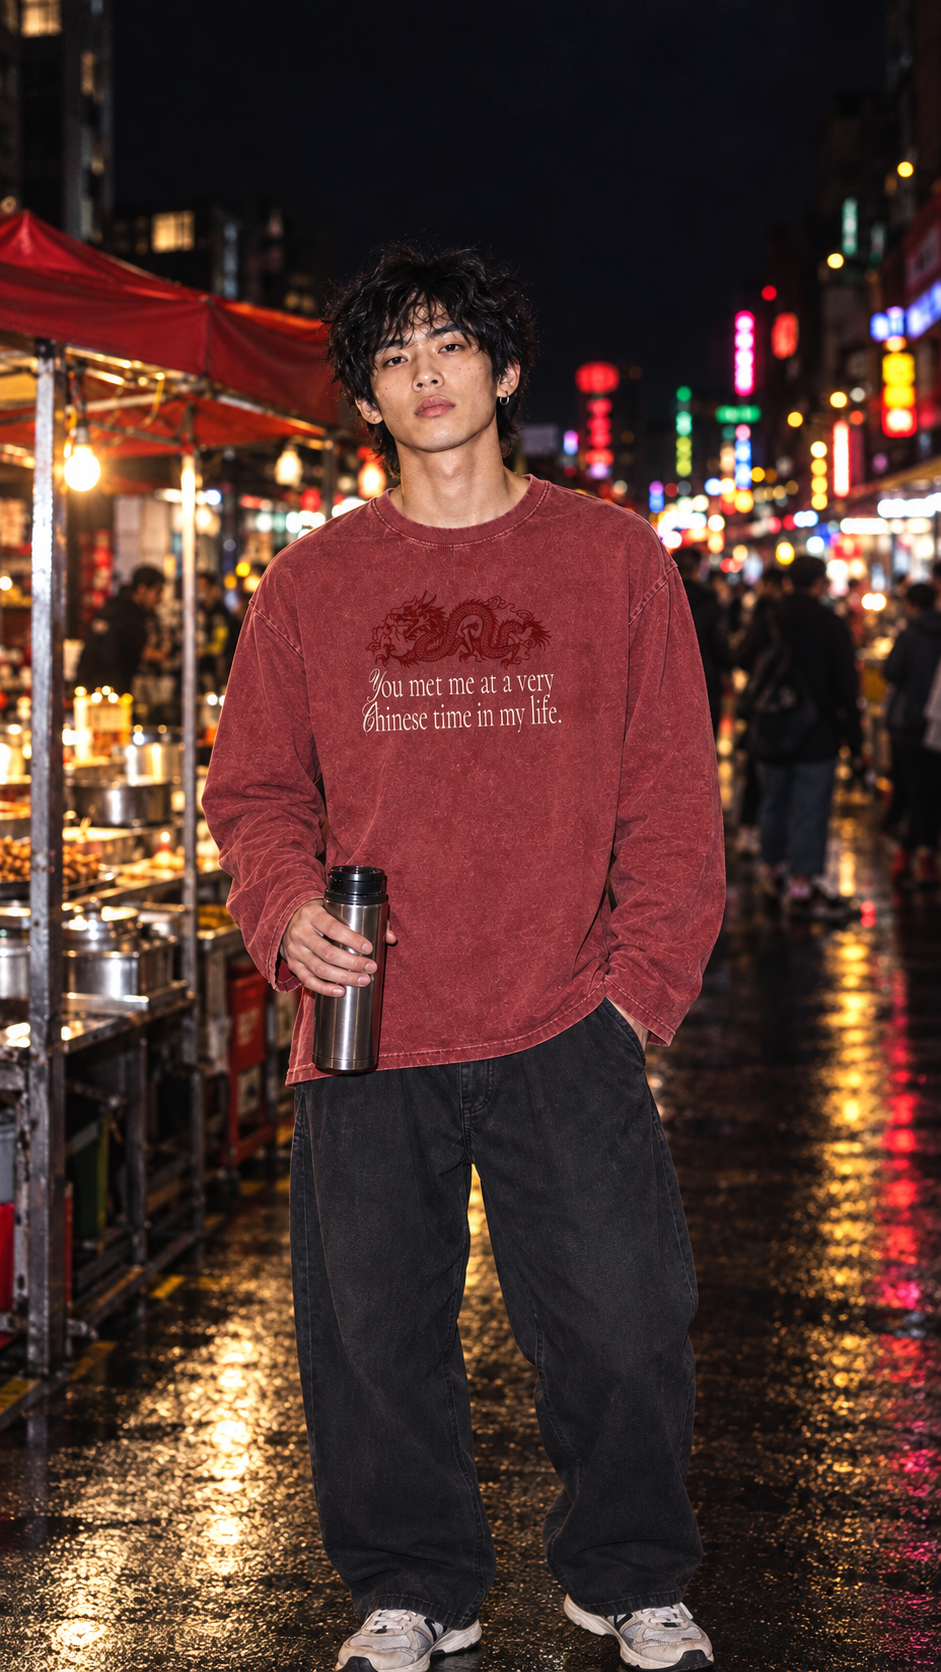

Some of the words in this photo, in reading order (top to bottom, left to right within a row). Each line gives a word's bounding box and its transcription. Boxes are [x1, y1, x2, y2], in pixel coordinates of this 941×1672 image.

[367, 667, 403, 702] You
[409, 676, 442, 697] met
[448, 675, 475, 695] me
[480, 674, 497, 694] at
[502, 674, 512, 693] a
[516, 673, 554, 697] very
[362, 701, 428, 734] Chinese
[433, 703, 472, 730] time
[477, 702, 494, 727] in
[499, 707, 525, 733] my
[530, 694, 562, 724] life.
